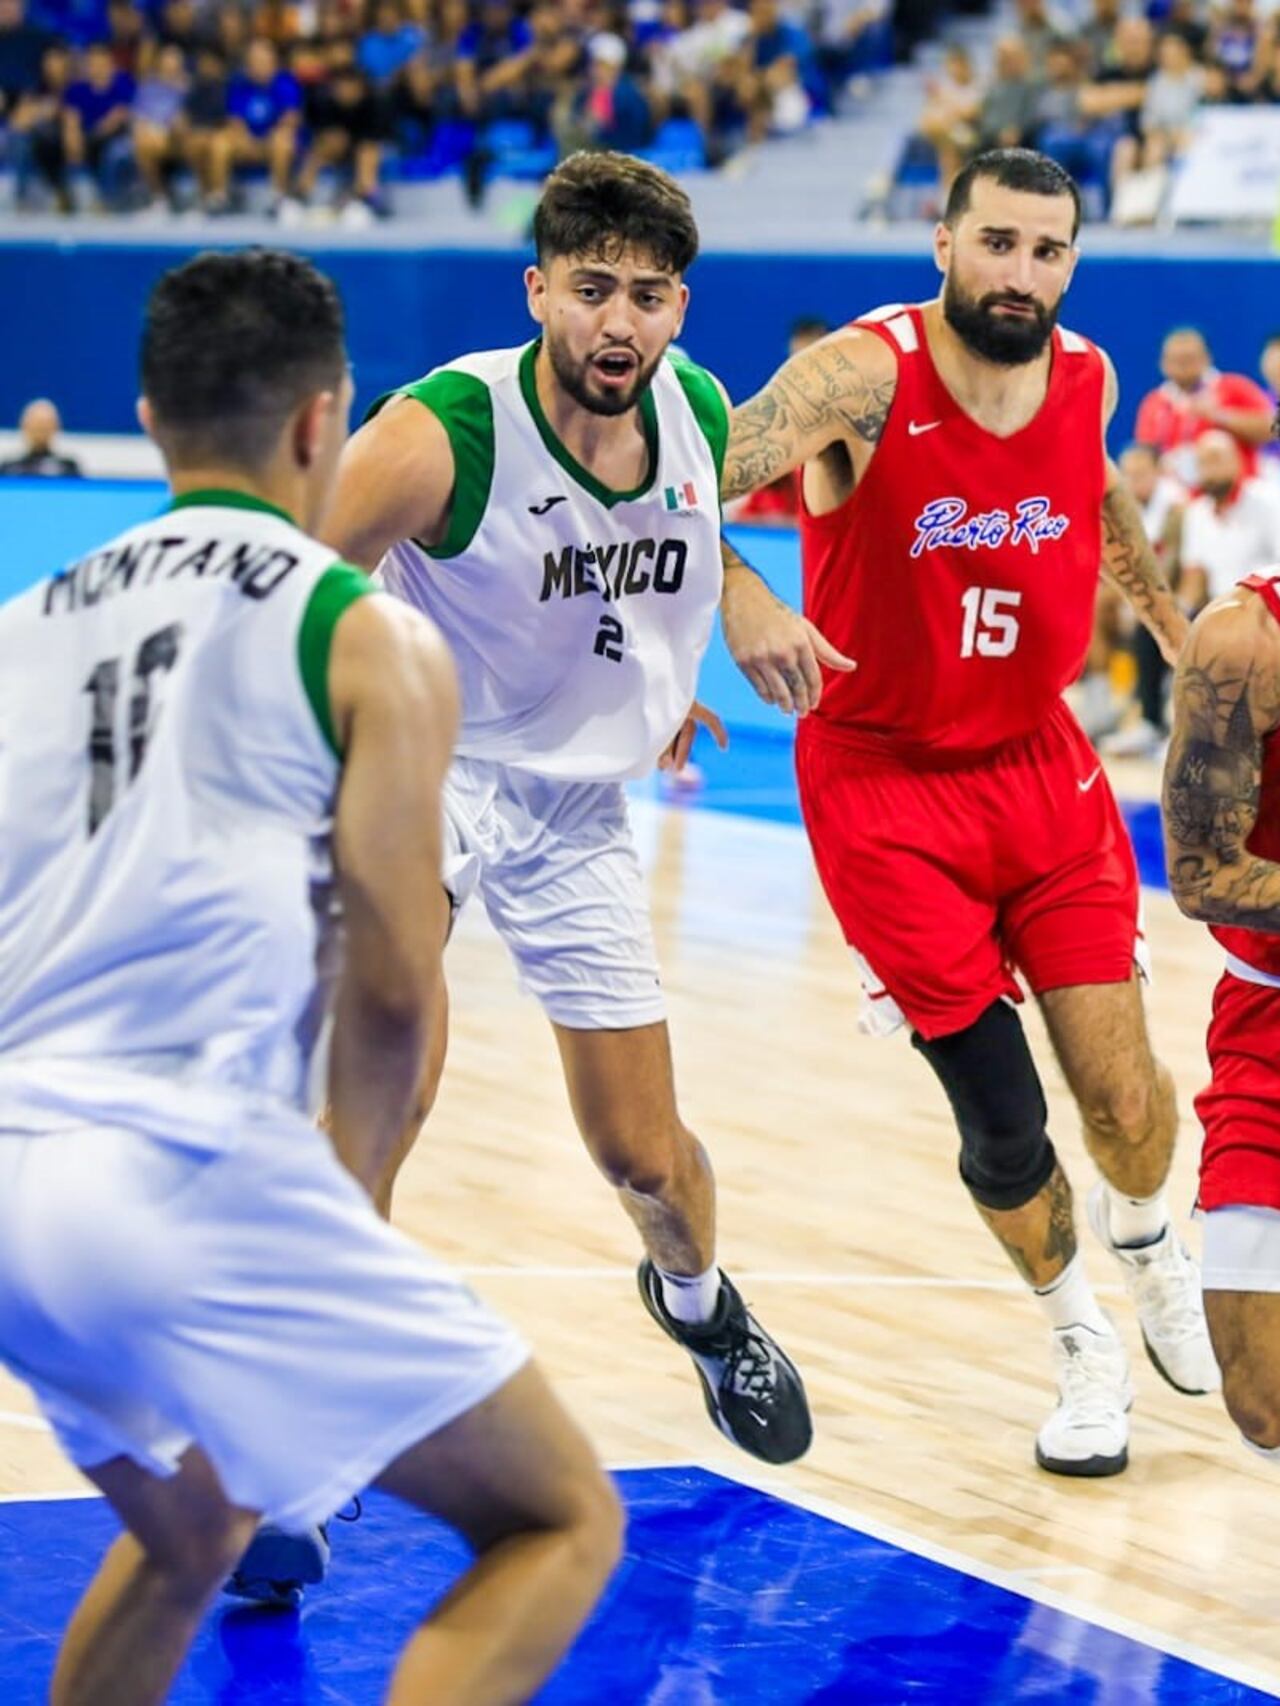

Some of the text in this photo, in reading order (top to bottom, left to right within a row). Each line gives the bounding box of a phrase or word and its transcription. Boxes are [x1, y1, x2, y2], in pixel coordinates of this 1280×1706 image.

[910, 497, 1011, 558] Puerto
[593, 614, 624, 663] 2
[960, 586, 1022, 659] 15
